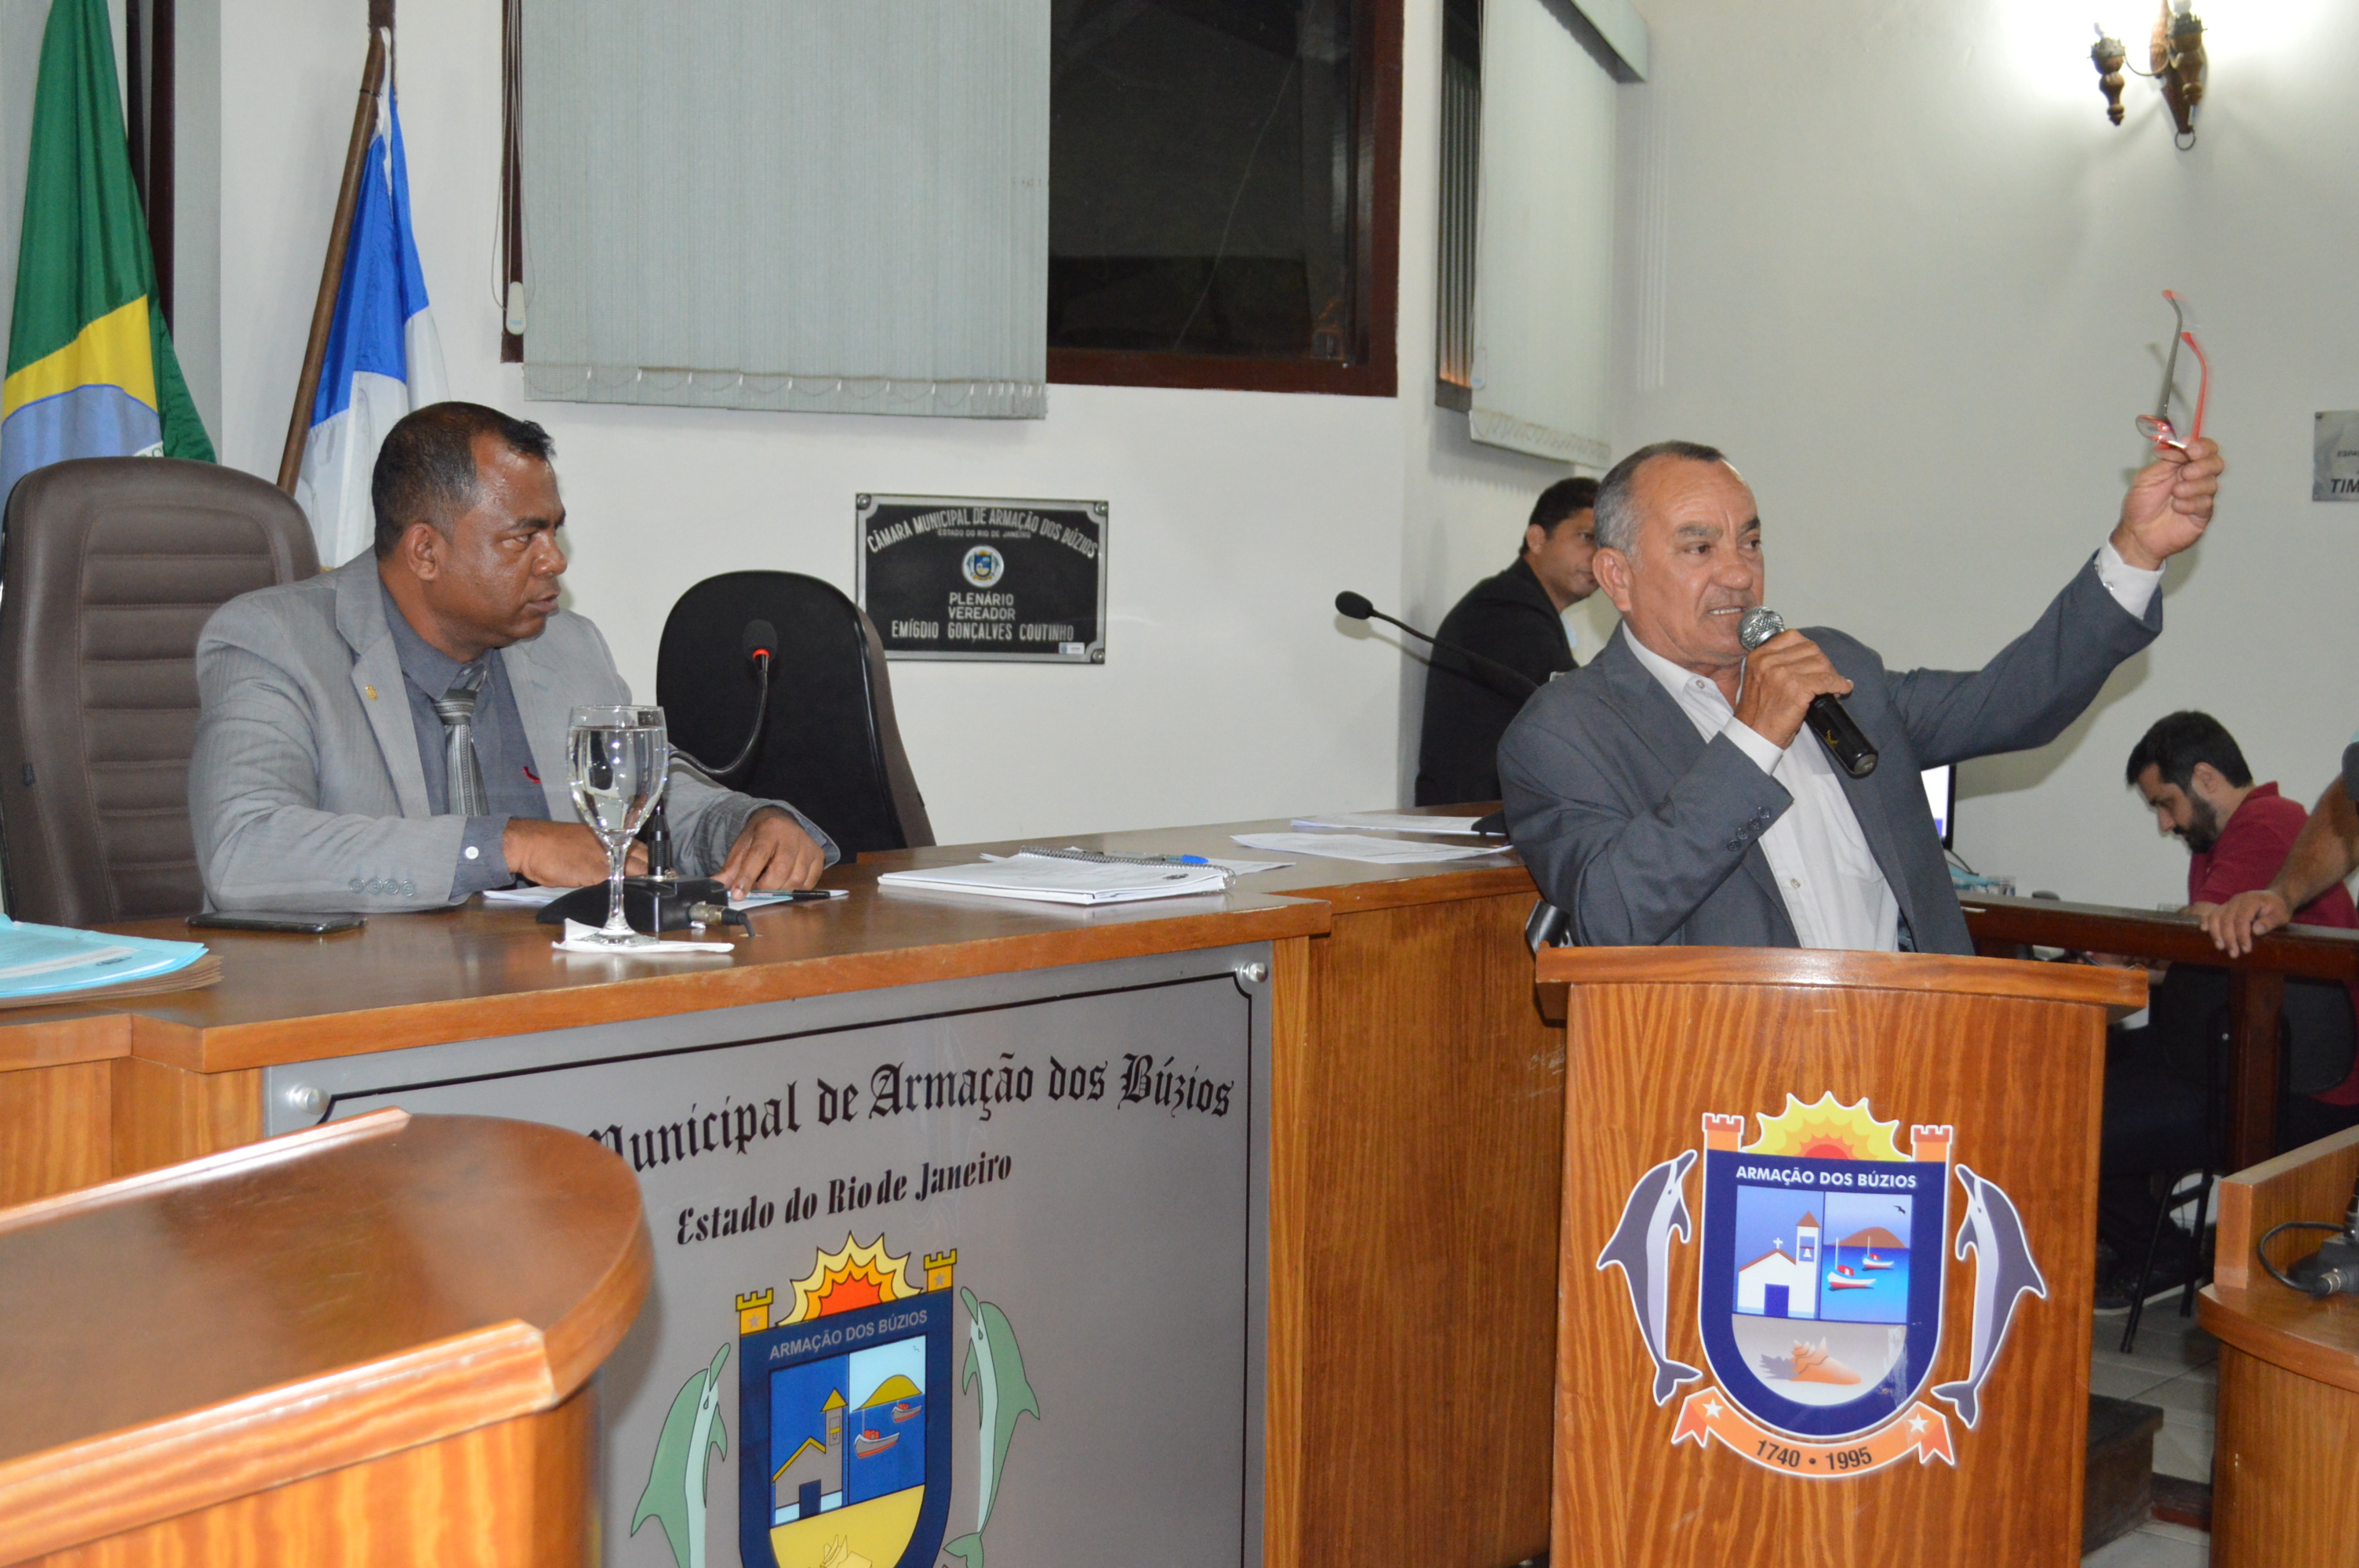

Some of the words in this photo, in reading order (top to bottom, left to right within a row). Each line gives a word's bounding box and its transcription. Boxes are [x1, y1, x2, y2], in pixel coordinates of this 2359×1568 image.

[867, 520, 914, 554] CÂMARA
[912, 508, 971, 534] MUNICIPAL
[972, 507, 987, 524] DE
[988, 508, 1039, 533] ARMAÇÃO
[1039, 518, 1063, 540] DOS
[1061, 527, 1098, 559] BÚZIOS
[937, 528, 964, 537] ESTADO
[976, 529, 989, 538] RIO
[1002, 530, 1031, 539] JANEIRO
[949, 591, 1014, 606] PLENÁRIO
[948, 606, 1016, 620] VEREADOR
[891, 619, 939, 638] EMÍGDIO
[947, 622, 1012, 642] GONÇALVES
[1019, 623, 1074, 641] COUTINHO
[817, 1077, 859, 1126] de
[868, 1051, 1034, 1121] Armação
[1048, 1055, 1108, 1101] dos
[1117, 1053, 1234, 1118] Búzios
[1736, 1166, 1815, 1185] ARMAÇÃO
[1819, 1171, 1853, 1186] DOS
[1857, 1170, 1917, 1188] BÚZIOS
[677, 1195, 775, 1245] Estado
[785, 1186, 817, 1224] do
[827, 1176, 872, 1215] Rio
[877, 1169, 907, 1205] de
[914, 1151, 1012, 1201] Janeiro
[769, 1330, 842, 1360] ARMAÇÃO
[846, 1322, 874, 1341] DOS
[878, 1310, 928, 1334] BÚZIOS
[1757, 1439, 1801, 1468] 1740
[1826, 1446, 1873, 1470] 1995
